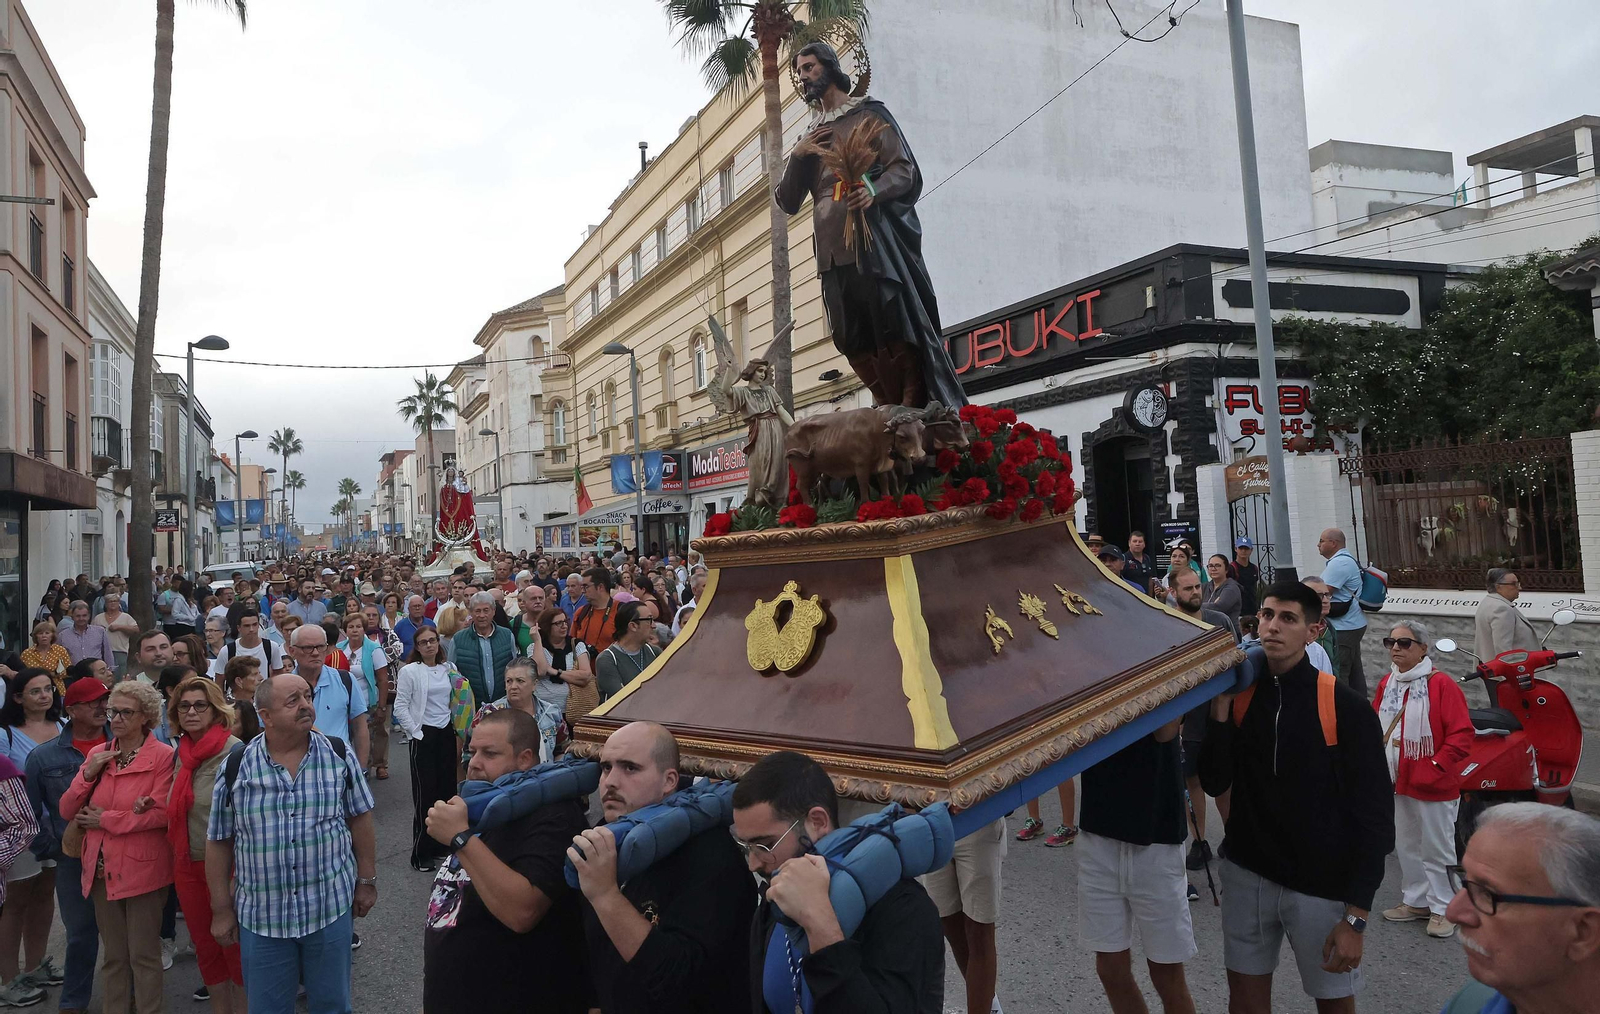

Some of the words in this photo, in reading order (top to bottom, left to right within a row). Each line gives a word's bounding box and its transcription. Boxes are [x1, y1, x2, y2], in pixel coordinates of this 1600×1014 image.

[944, 289, 1103, 375] UBUKI
[692, 441, 746, 477] ModaTech!
[1236, 463, 1248, 477] El
[1242, 478, 1271, 491] Fubuk
[643, 498, 674, 514] Coffee
[157, 516, 177, 524] 24
[583, 517, 624, 525] BOCADILLOS
[1480, 779, 1497, 788] Chill
